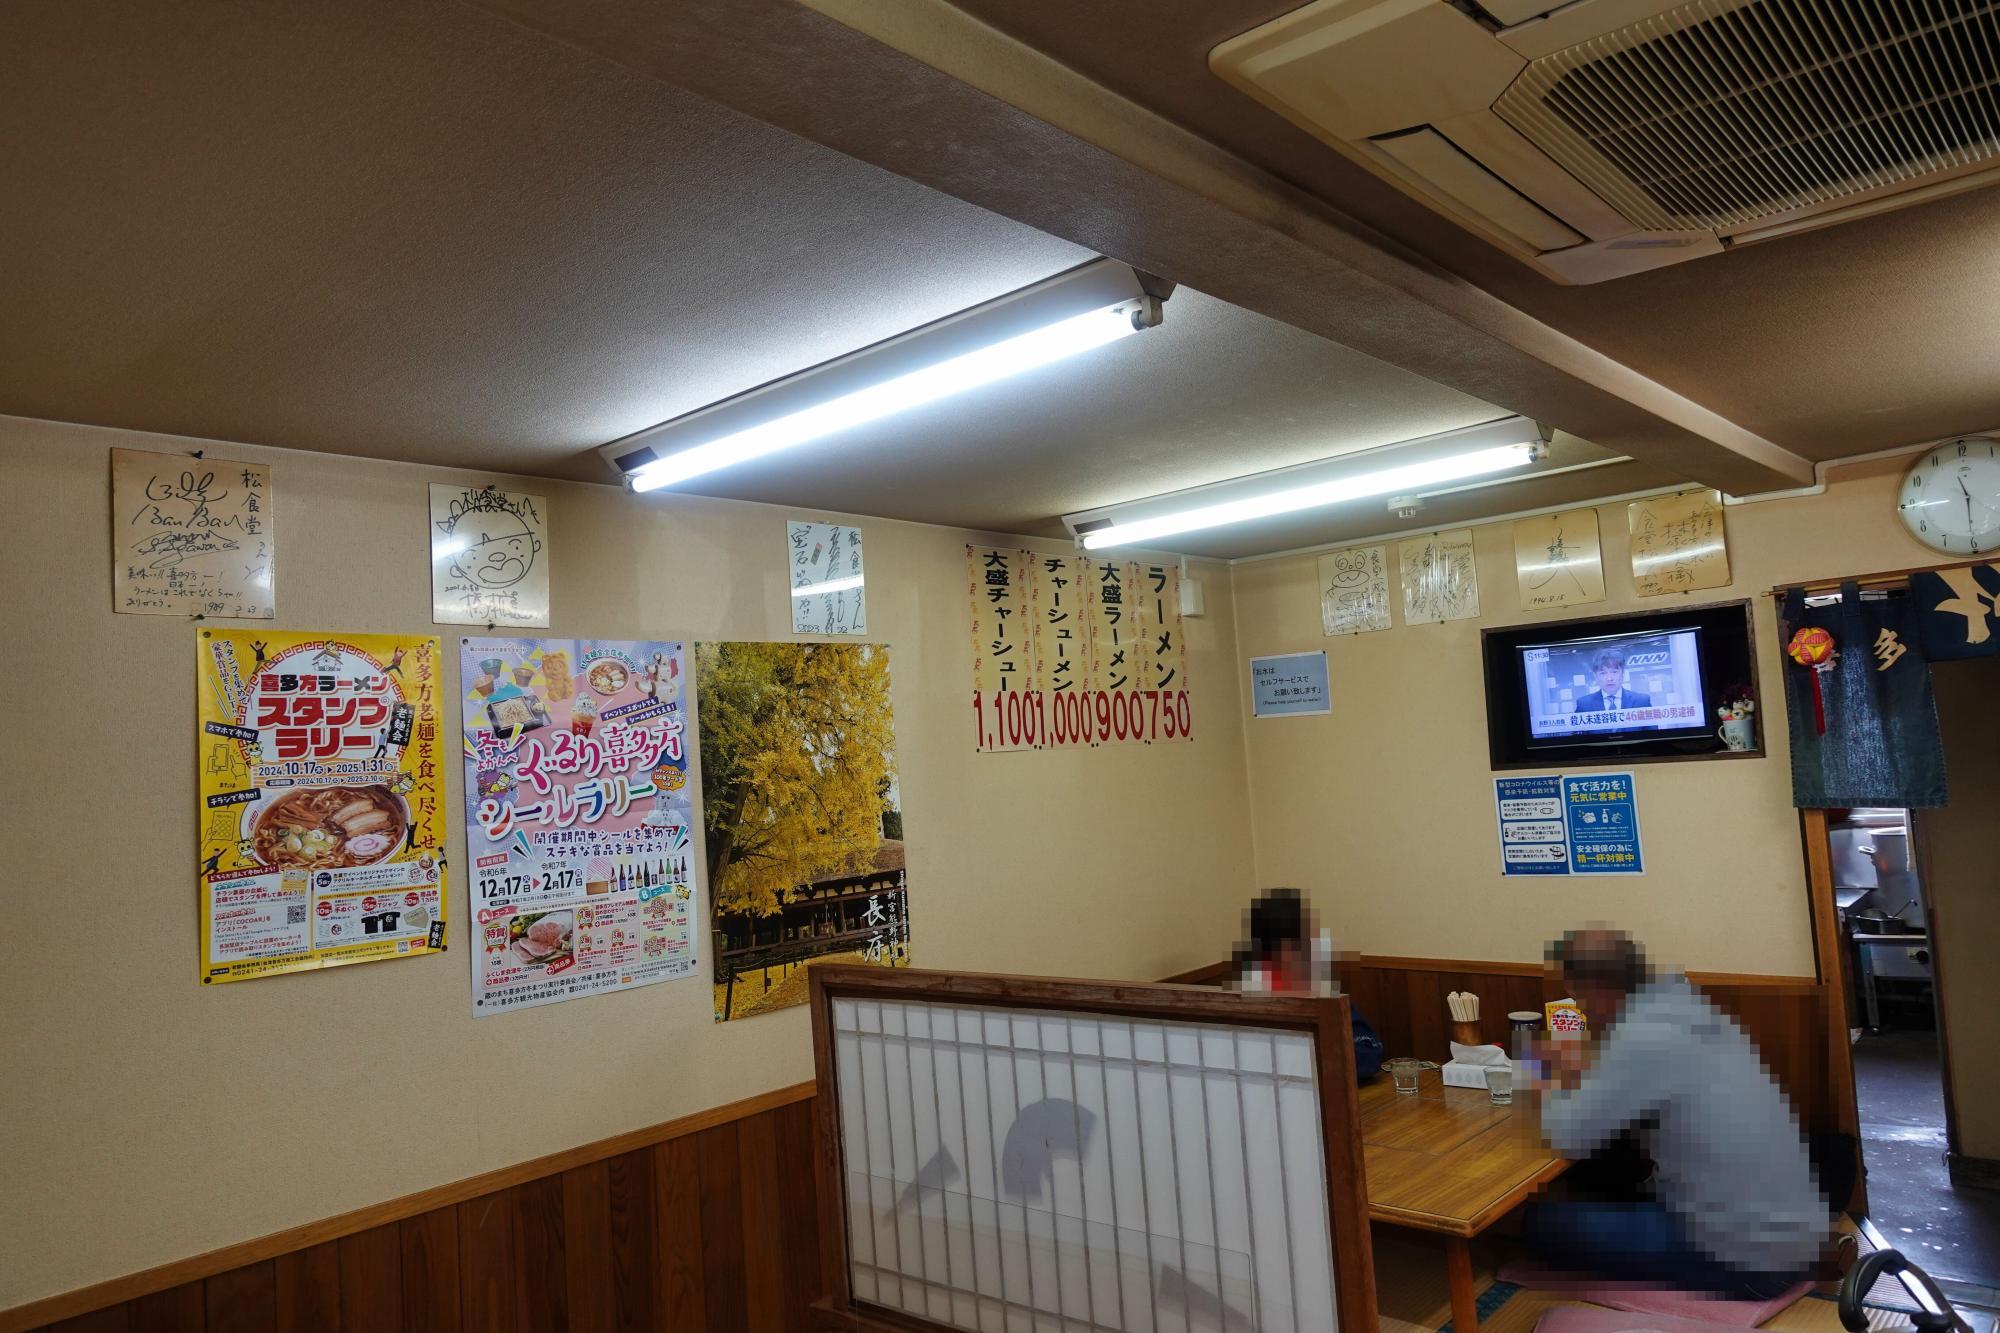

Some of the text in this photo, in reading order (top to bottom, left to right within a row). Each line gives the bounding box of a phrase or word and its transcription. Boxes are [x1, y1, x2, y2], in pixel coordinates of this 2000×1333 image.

[1958, 446, 1967, 457] 12
[1932, 456, 1939, 467] 11
[1913, 475, 1921, 488] 10
[1920, 520, 1927, 533] 8
[1941, 534, 1947, 547] 7
[1970, 537, 1978, 549] 6
[983, 551, 1017, 692] 大盛チャーシュー
[1044, 558, 1073, 692] チャーシューメン
[1099, 563, 1128, 690] 大盛ラーメン
[1148, 567, 1176, 688] ラーメン
[1873, 627, 1908, 671] 多
[1627, 653, 1668, 665] NNN
[1256, 667, 1275, 676] お水は
[261, 674, 389, 692] 喜多方ラーメン
[1260, 676, 1309, 686] セルフサービスで
[257, 696, 390, 727] スタンプ
[604, 698, 657, 720] イベント・スポットでも
[629, 703, 675, 723] シールがもらえる!
[973, 690, 1191, 750] 1,100 1,000 900 750
[208, 724, 256, 740] スマホで参加!
[276, 728, 372, 758] ラリー
[477, 730, 507, 756] 冬も
[516, 720, 680, 790] ぐるり喜多方
[477, 754, 517, 770] よかんべ
[1499, 780, 1560, 788] 新型コロナウイルス等の
[1569, 780, 1626, 793] 食で活力を!
[210, 791, 257, 806] チラシで参加!
[1570, 791, 1628, 803] 元気に営業中
[479, 780, 654, 836] シールラリー
[534, 829, 672, 845] 開催期間中シールを集めて
[546, 841, 668, 857] ステキな賞品を当てよう!
[1576, 844, 1634, 853] 安全確保の為に
[1577, 853, 1635, 863] 精一杯対策中
[479, 867, 508, 878] 令和6年
[541, 861, 567, 871] 令和7年
[653, 887, 665, 895] コース
[334, 905, 358, 913] 手ぬぐい
[494, 908, 510, 917] コース
[216, 925, 248, 933] インストール
